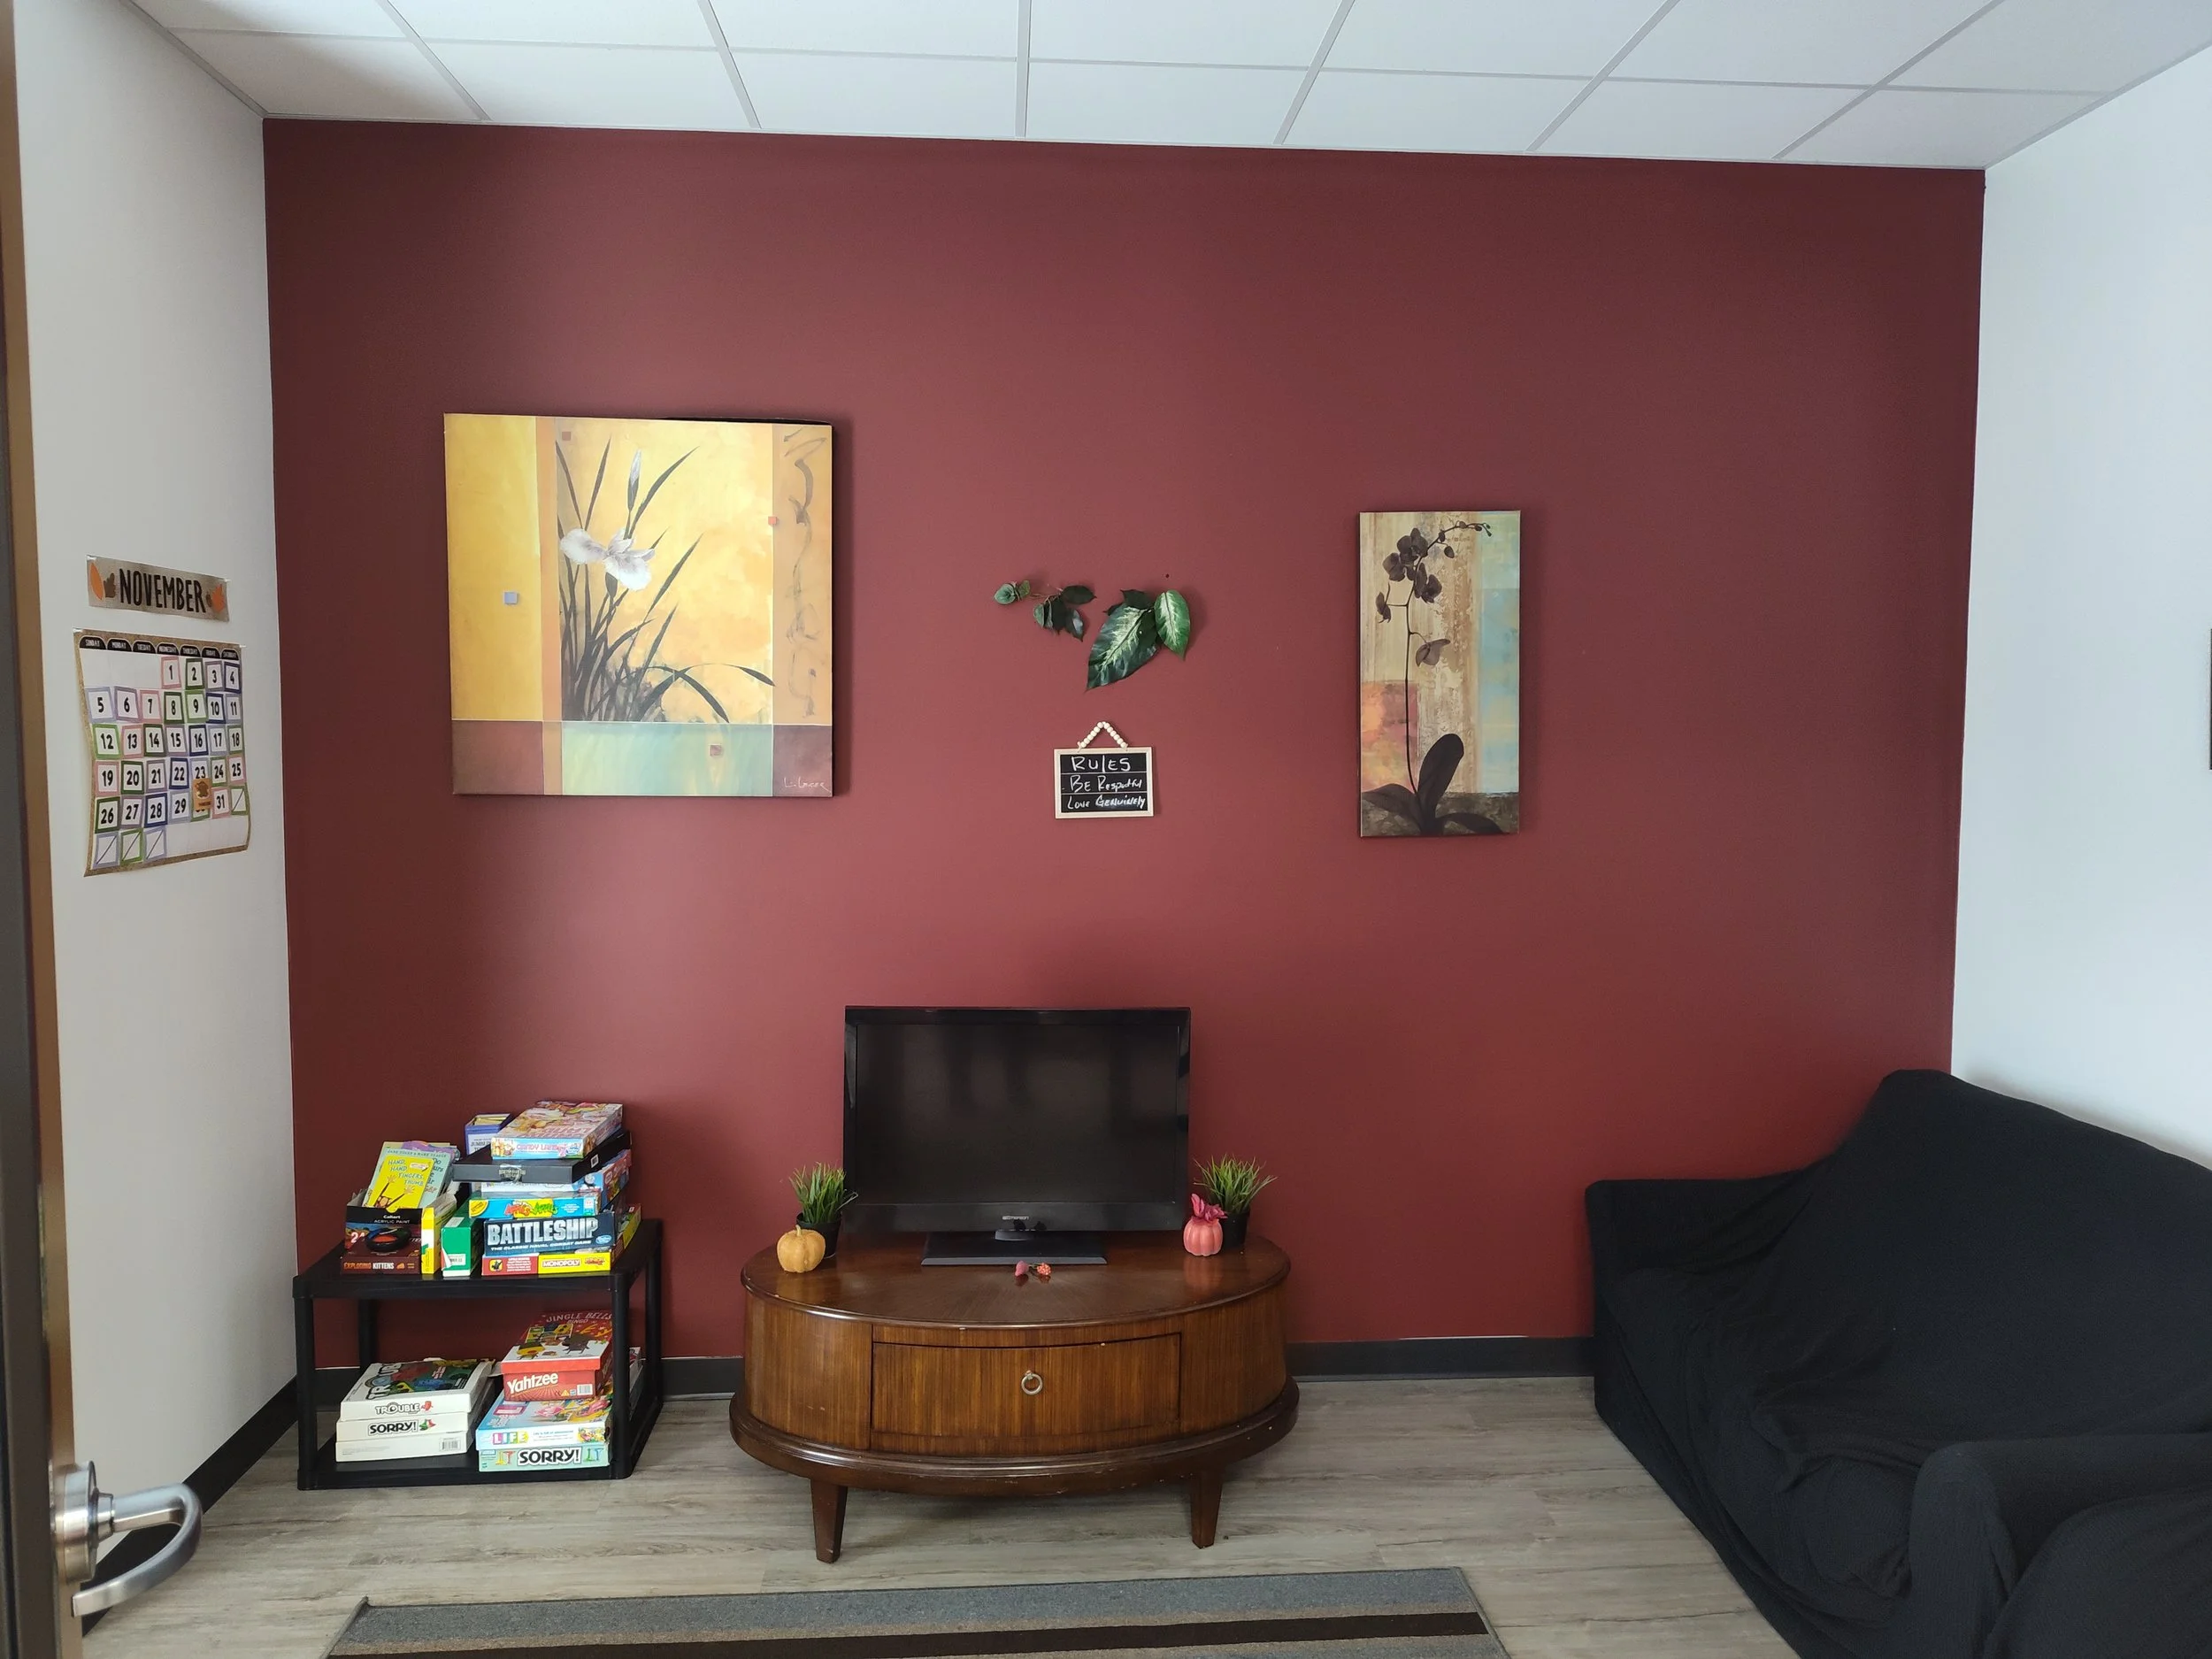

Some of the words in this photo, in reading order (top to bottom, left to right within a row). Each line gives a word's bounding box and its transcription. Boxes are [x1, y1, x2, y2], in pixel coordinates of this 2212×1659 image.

[119, 568, 206, 613] NOVEMBER
[168, 665, 173, 680] 1
[191, 667, 197, 681] 2
[211, 670, 218, 683] 3
[229, 671, 235, 685] 4
[97, 697, 104, 713] 5
[124, 697, 130, 712] 6
[148, 699, 153, 713] 7
[171, 700, 176, 715] 8
[193, 699, 198, 713] 9
[211, 702, 219, 716] 10
[230, 702, 237, 716] 11
[101, 733, 113, 749] 12
[127, 733, 138, 749] 13
[149, 733, 159, 748] 14
[171, 733, 181, 748] 15
[194, 733, 203, 748] 16
[213, 733, 222, 747] 17
[232, 733, 240, 747] 18
[102, 770, 113, 787] 19
[127, 771, 140, 786] 20
[151, 768, 162, 784] 21
[174, 767, 185, 781] 22
[195, 766, 206, 779] 23
[214, 764, 224, 779] 24
[232, 763, 242, 777] 25
[101, 807, 113, 825] 26
[126, 804, 139, 819] 27
[150, 803, 162, 818] 28
[175, 798, 187, 814] 29
[216, 795, 225, 809] 31
[487, 1217, 599, 1246] BATTLESHIP
[546, 1312, 582, 1323] JINGLE
[585, 1311, 612, 1320] BELLS
[507, 1372, 558, 1394] Yahtzee
[375, 1402, 420, 1415] TROUBLE
[369, 1421, 418, 1434] SORRY!
[493, 1432, 527, 1445] LIFE
[519, 1448, 580, 1464] SORRY!
